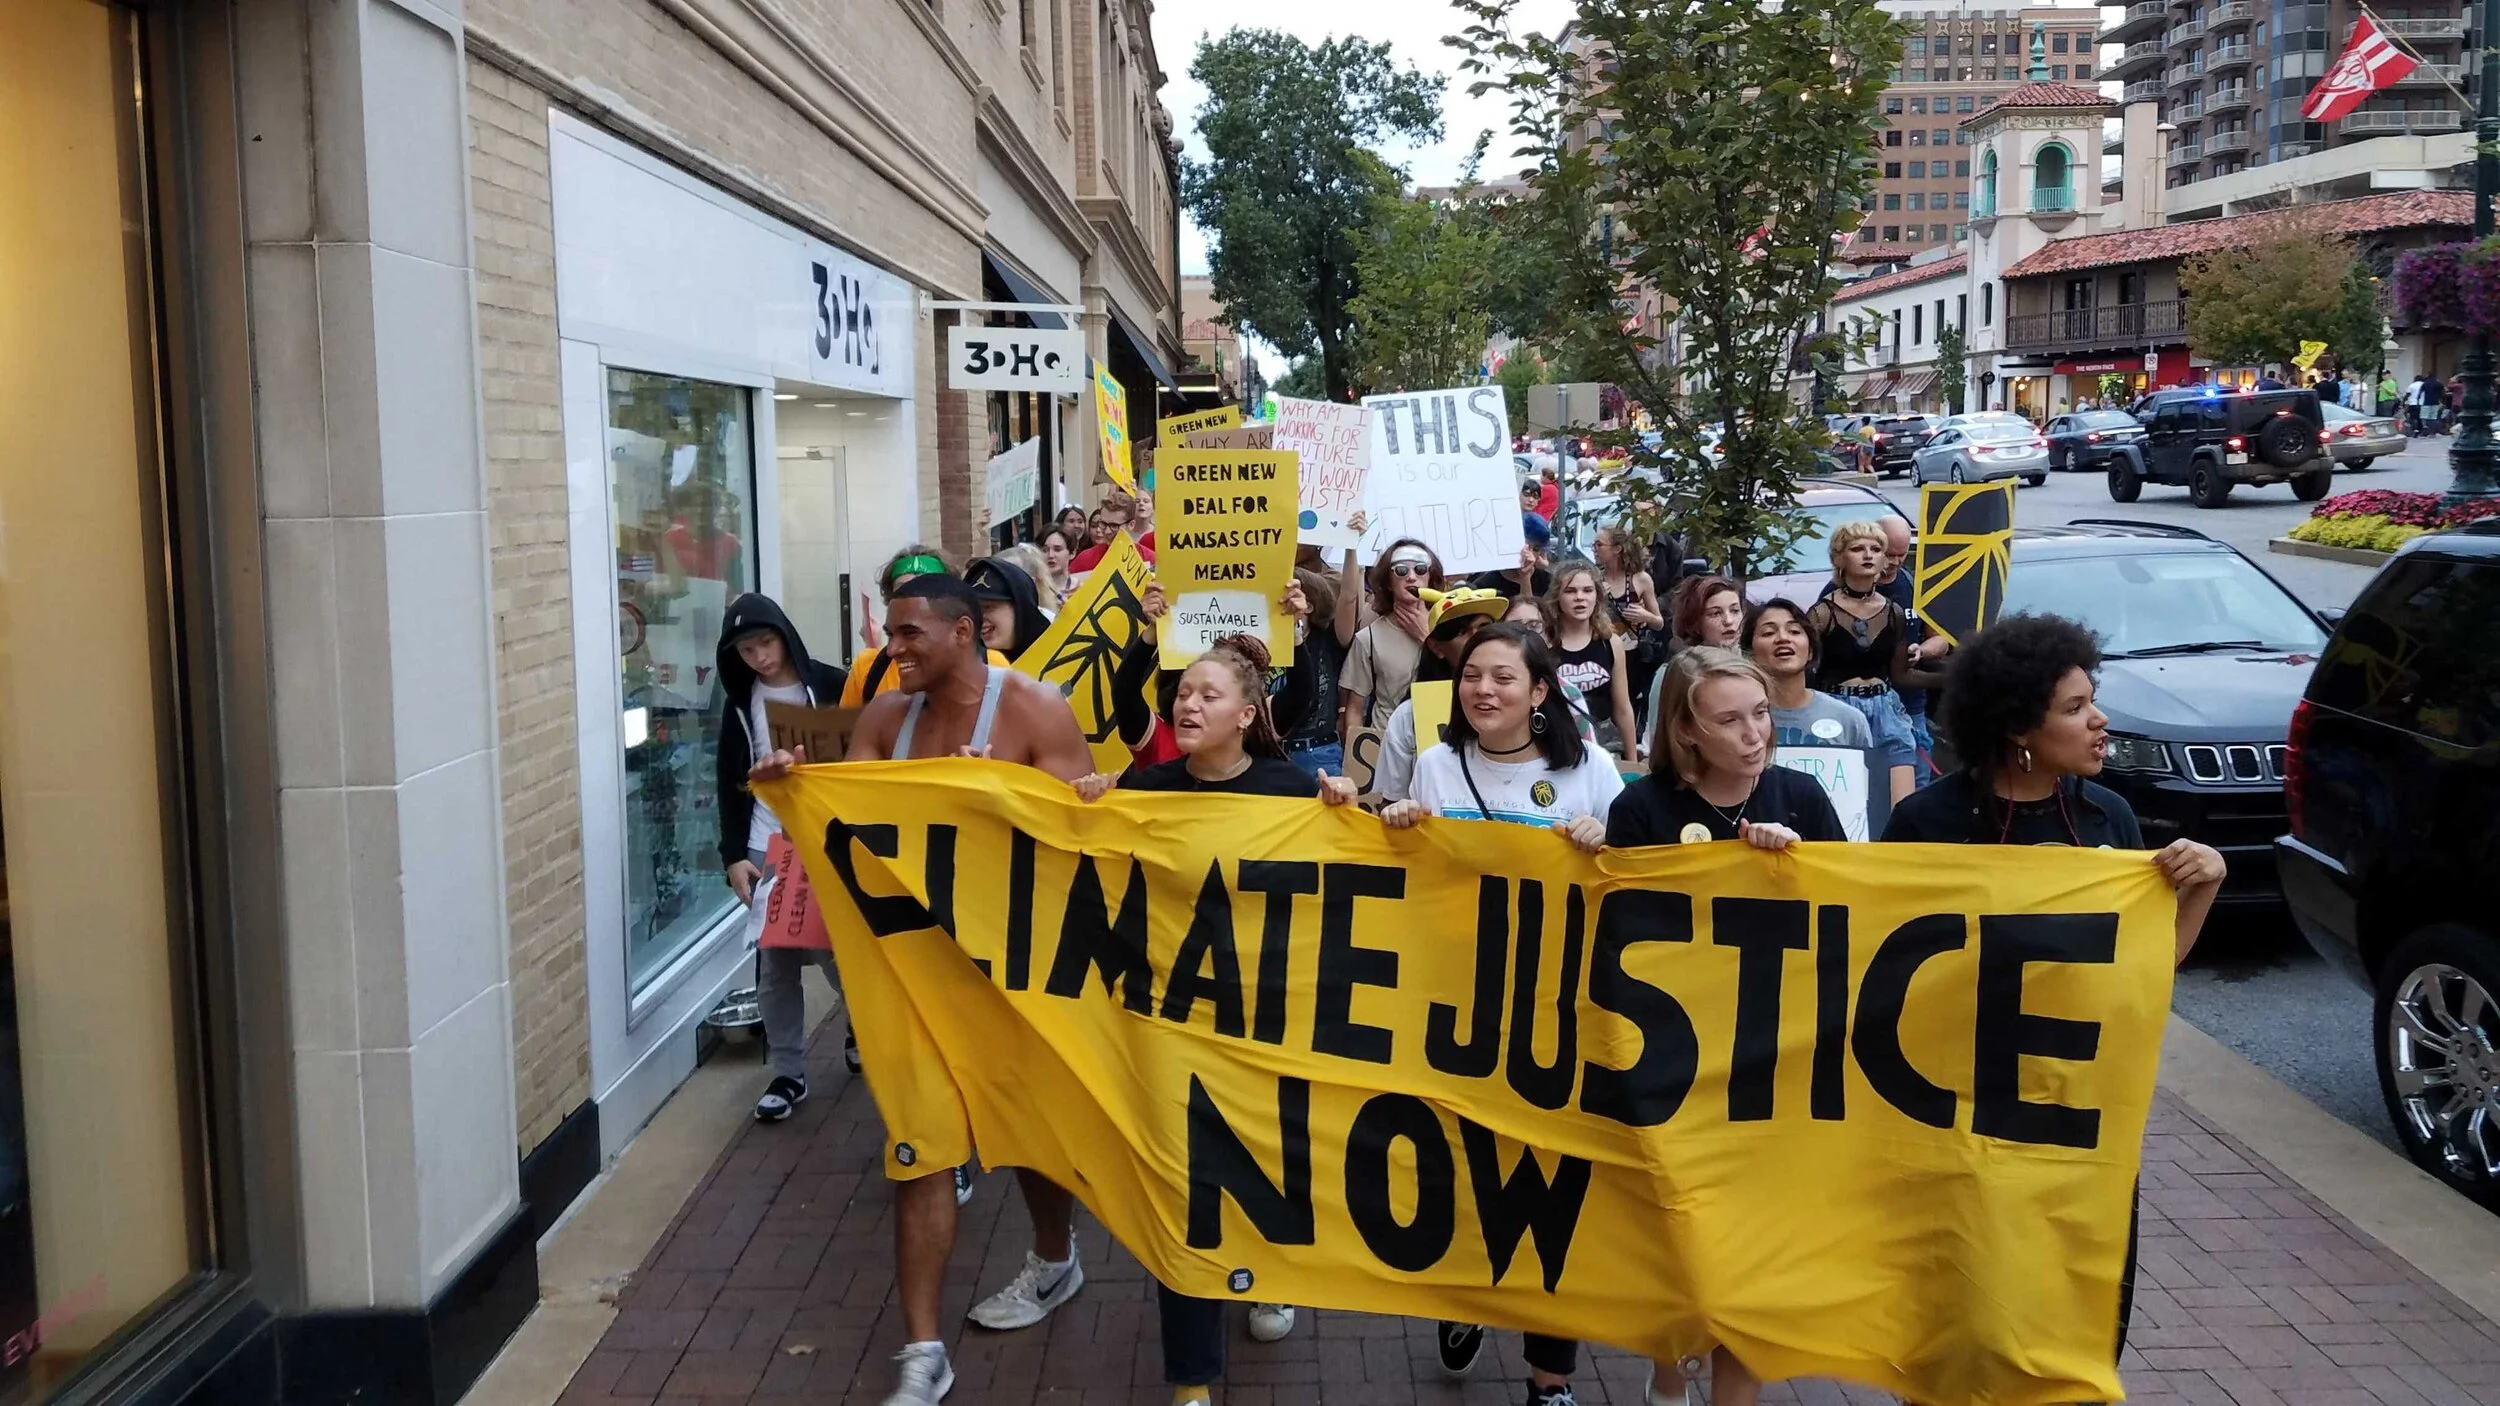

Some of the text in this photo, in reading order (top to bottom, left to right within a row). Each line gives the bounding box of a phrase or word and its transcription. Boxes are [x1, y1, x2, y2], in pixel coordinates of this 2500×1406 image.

[1169, 414, 1227, 435] GREEN NEW
[1281, 399, 1313, 419] WHY
[1316, 404, 1341, 422] AM
[1355, 409, 1369, 427] I
[1367, 388, 1502, 459] THIS
[1332, 425, 1361, 446] FOR
[1293, 440, 1359, 466] FUTURE
[1173, 463, 1276, 482] GREEN NEW
[1298, 462, 1367, 491] AT WONT
[1183, 496, 1268, 515] DEAL FOR
[1298, 485, 1356, 512] XIST?
[1169, 528, 1282, 550] KANSAS CITY
[1379, 497, 1521, 561] FUTURE
[1194, 563, 1256, 580] MEANS
[1208, 596, 1221, 613] A
[1178, 612, 1259, 627] SUSTAINABLE
[824, 817, 2120, 1150] CLIMATE JUSTICE
[1185, 1072, 1593, 1296] NOW
